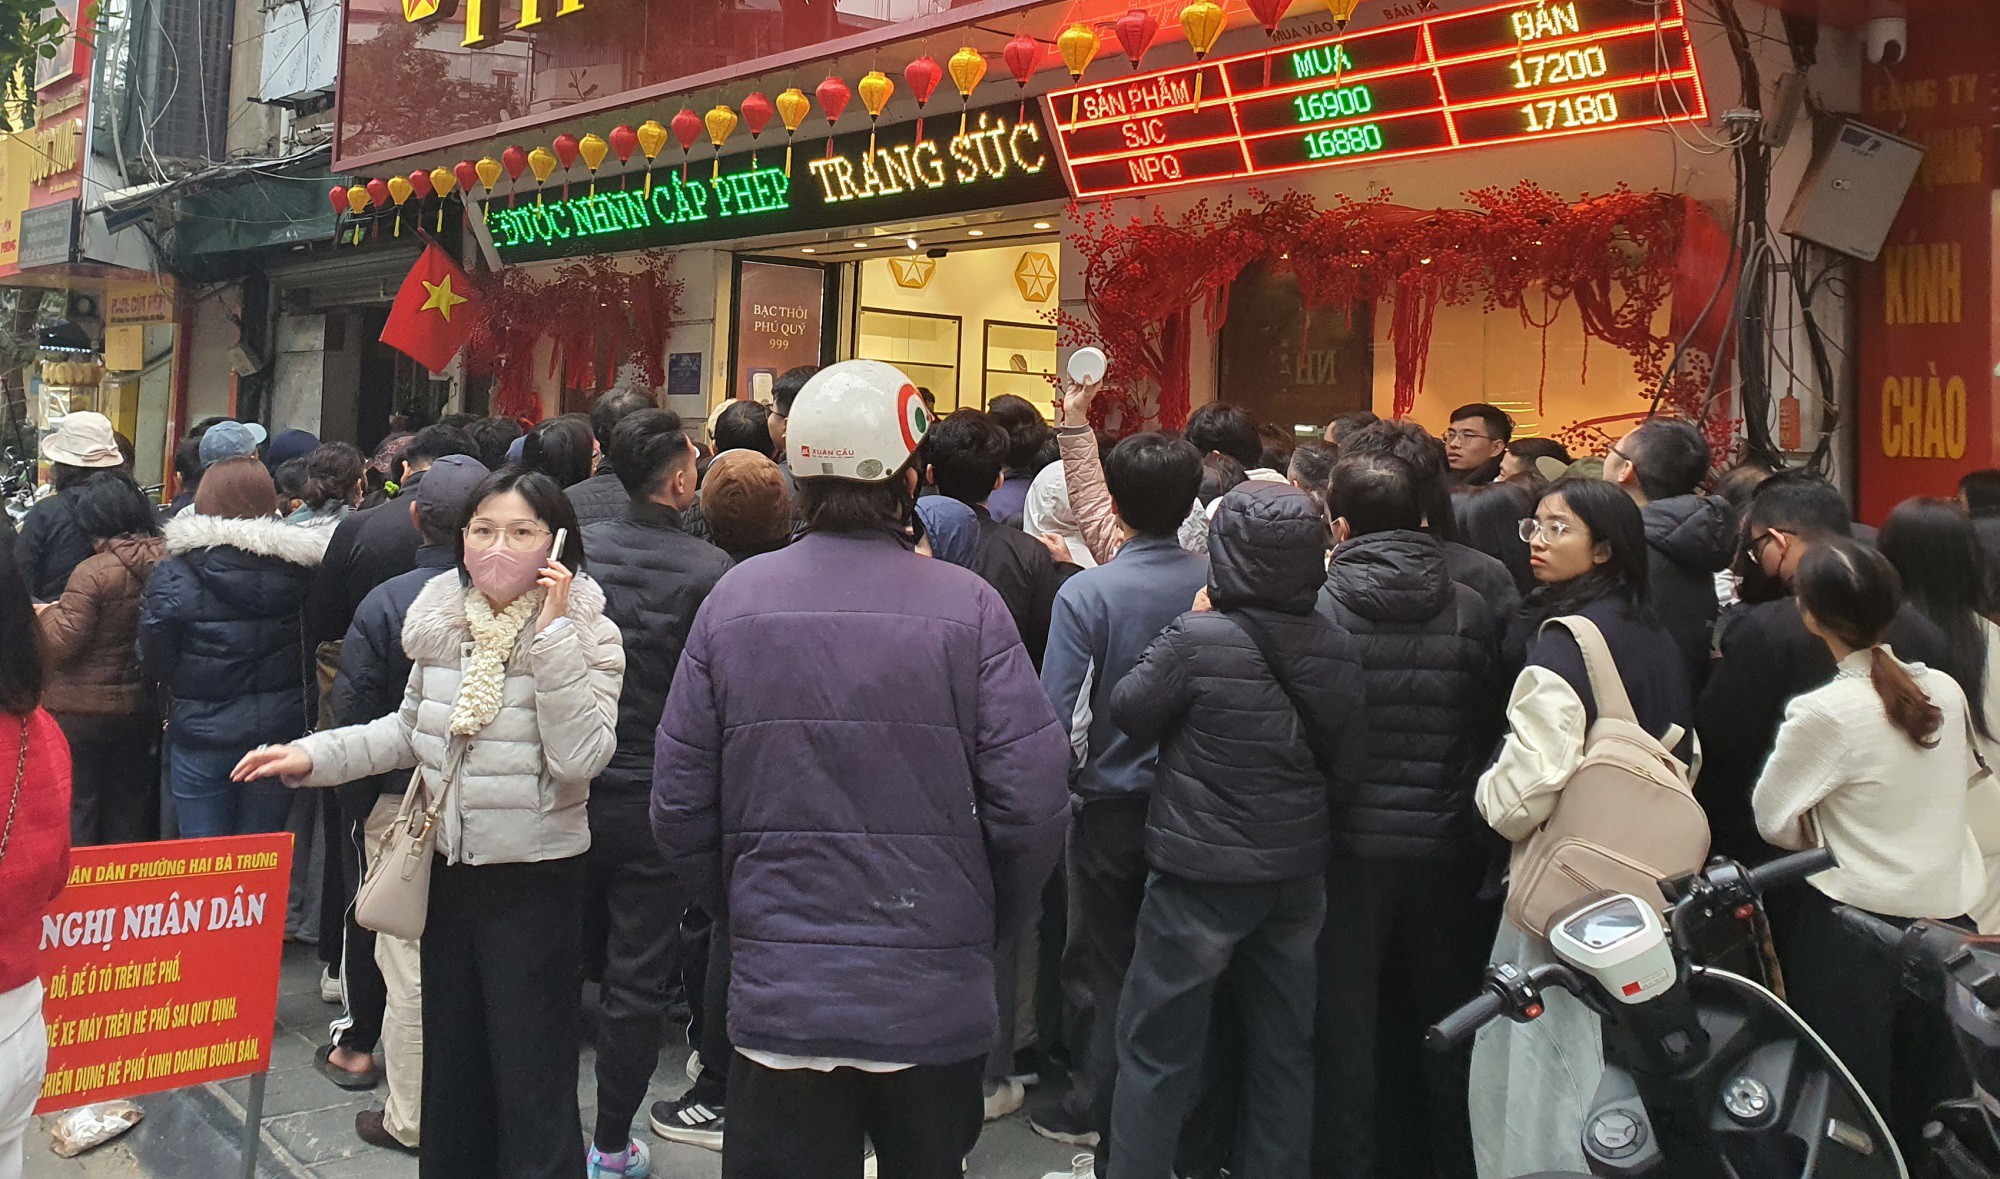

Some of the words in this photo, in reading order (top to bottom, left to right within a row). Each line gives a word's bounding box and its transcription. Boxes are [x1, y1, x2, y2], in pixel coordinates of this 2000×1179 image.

[1383, 4, 1416, 20] BÁN
[1511, 1, 1580, 42] BÁN
[1272, 28, 1303, 43] MUA
[1302, 20, 1334, 38] VÀO
[1292, 43, 1351, 80] MUA
[1508, 45, 1608, 89] 17200
[1083, 87, 1125, 120] SẢN
[1130, 75, 1190, 114] PHẨM
[1293, 85, 1372, 123] 16900
[1946, 73, 1979, 104] TY
[1520, 91, 1619, 133] 17180
[1121, 118, 1166, 149] SJC
[1303, 124, 1383, 160] 16880
[808, 141, 947, 203] TRANG
[949, 113, 1046, 184] SỨC
[1127, 154, 1182, 184] NPQ
[500, 202, 571, 246] ĐƯỢC
[652, 170, 708, 225] CẤP
[710, 158, 789, 217] PHÉP
[753, 304, 777, 318] BẠC
[754, 320, 779, 333] PHÚ
[781, 322, 806, 337] QUÝ
[769, 338, 789, 350] 999
[1881, 361, 1967, 459] CHÀO
[67, 862, 92, 885] ÂN
[95, 861, 125, 882] DÂN
[129, 857, 186, 879] PHƯỜNG
[189, 856, 211, 874] HAI
[215, 852, 233, 871] BÀ
[236, 851, 279, 869] TRƯNG
[38, 907, 117, 952] NGHỊ
[120, 891, 204, 940] NHÂN
[206, 884, 267, 931] DÂN
[70, 962, 89, 997] ĐỂ
[87, 964, 97, 994] Ô
[99, 962, 112, 993] TÔ
[114, 960, 142, 991] TRÊN
[158, 950, 181, 984] PHỐ.
[59, 1020, 77, 1047] XE
[77, 1012, 104, 1043] MÁY
[104, 1007, 131, 1040] TRÊN
[132, 1005, 148, 1034] HÈ
[148, 997, 173, 1032] PHỐ
[171, 1003, 188, 1028] SAI
[190, 1000, 210, 1027] QUY
[212, 997, 238, 1027] ĐỊNH.
[74, 1066, 105, 1096] DỤNG
[107, 1055, 122, 1089] HÈ
[122, 1048, 148, 1084] PHỐ
[146, 1052, 173, 1080] KINH
[173, 1045, 208, 1074] DOANH
[208, 1038, 237, 1068] BUÔN
[237, 1035, 260, 1064] BÁN.
